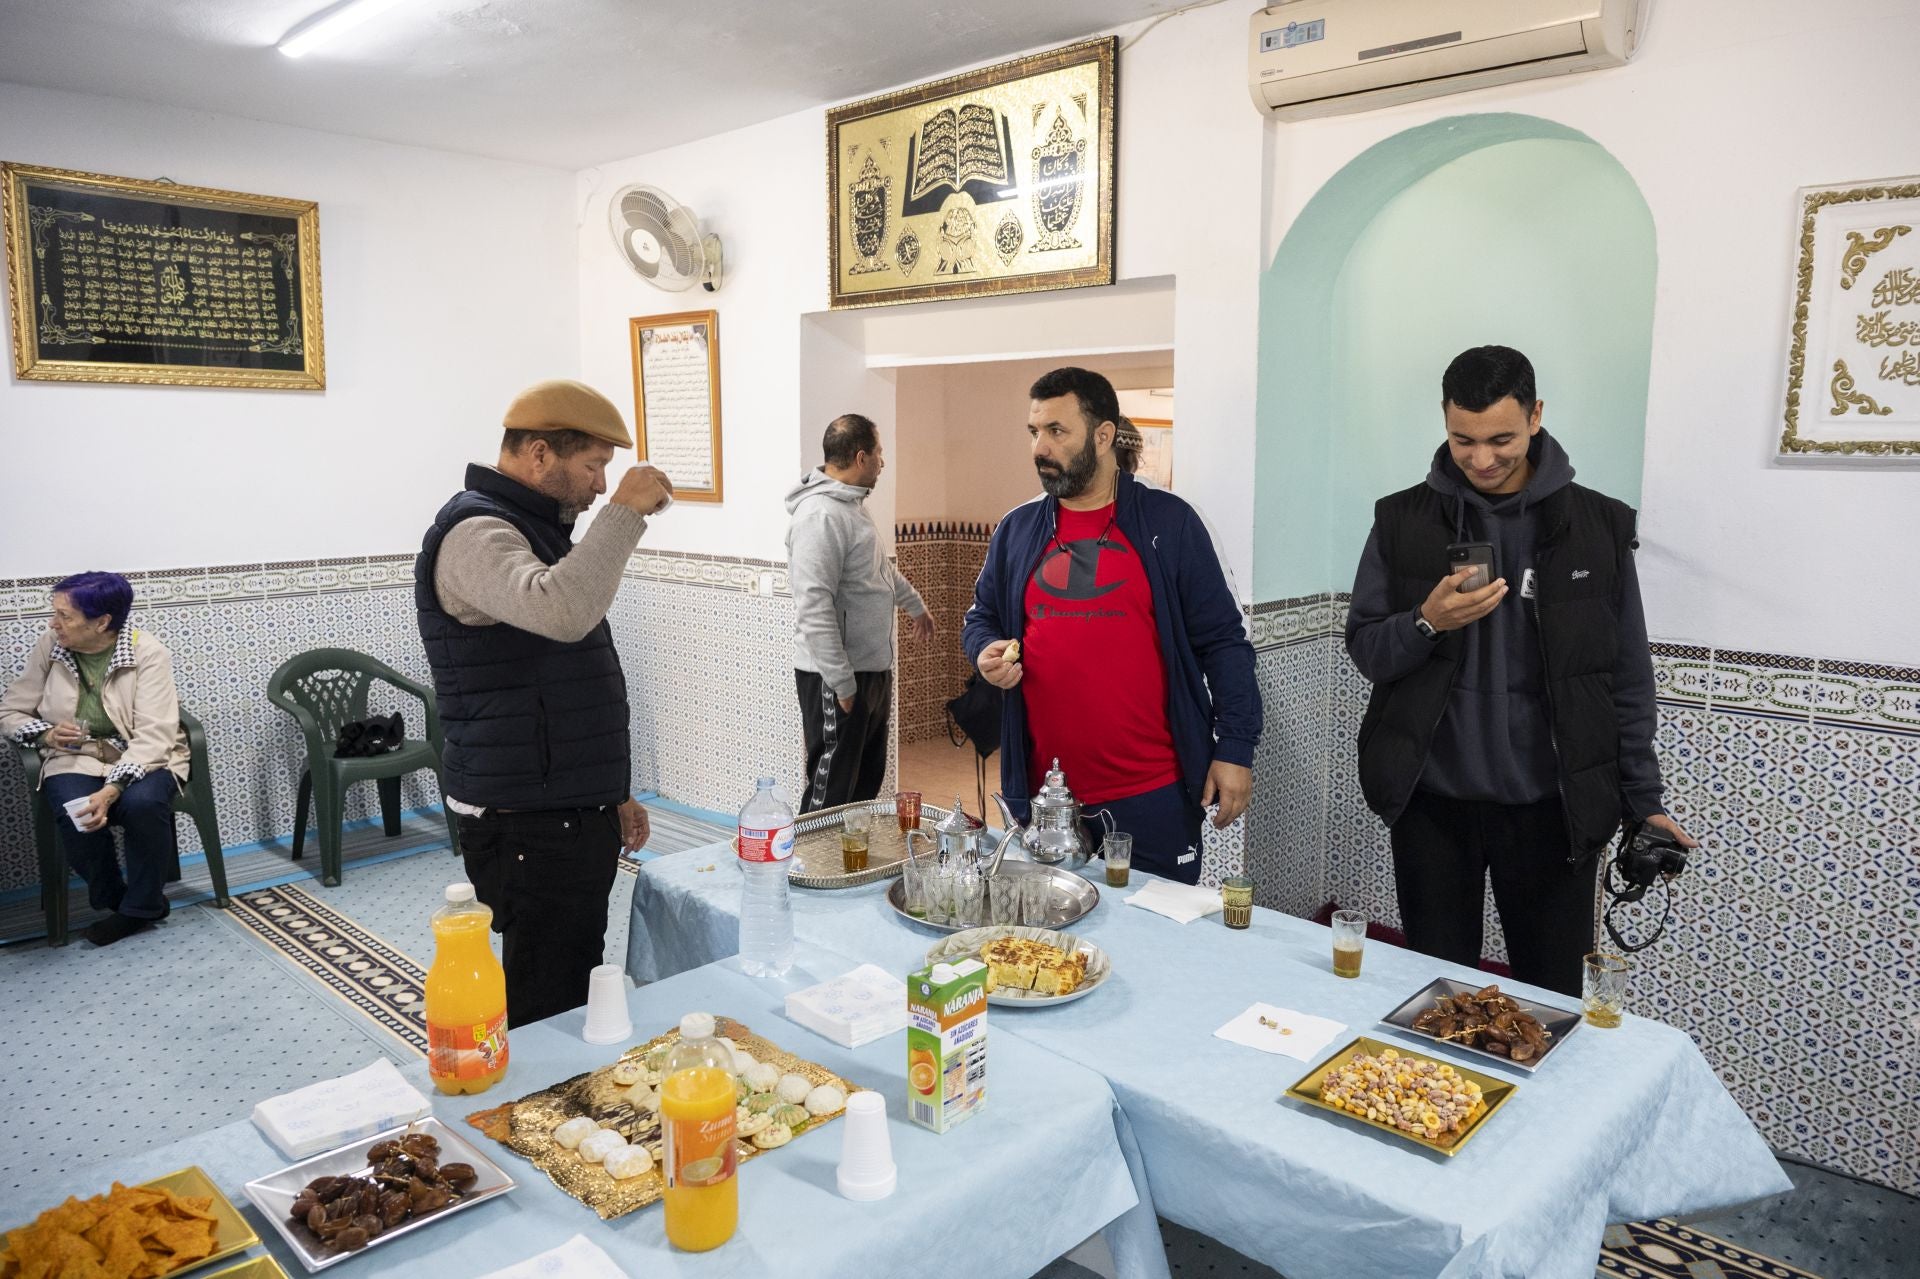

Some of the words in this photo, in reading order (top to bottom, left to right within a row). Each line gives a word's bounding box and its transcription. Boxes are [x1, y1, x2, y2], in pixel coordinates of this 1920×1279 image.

[1030, 603, 1127, 623] Champion
[1177, 852, 1195, 865] PUMA
[943, 986, 984, 1017] NARANJA
[910, 1003, 938, 1020] NARANJA
[700, 1115, 733, 1133] Zumo
